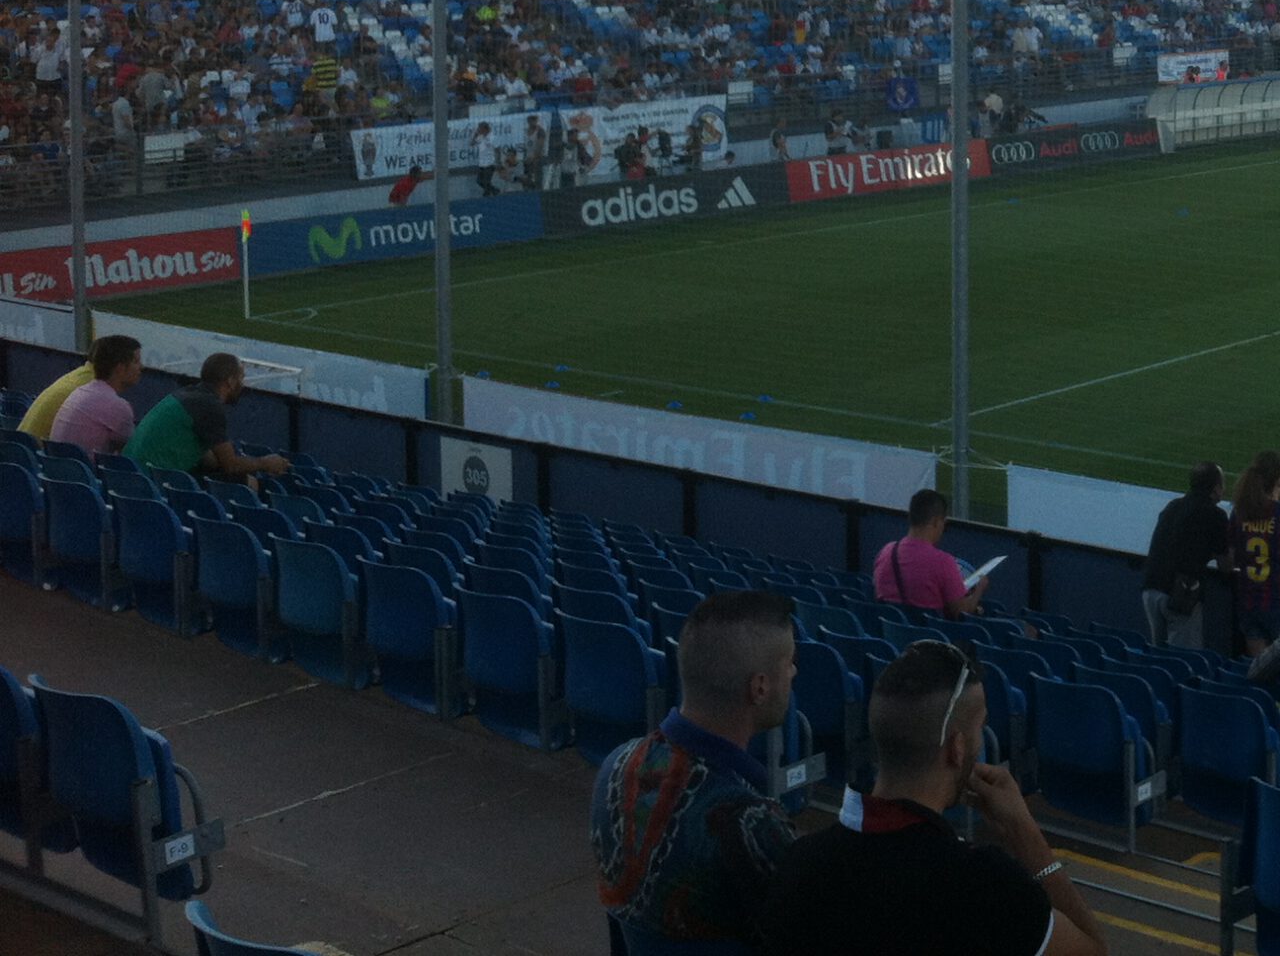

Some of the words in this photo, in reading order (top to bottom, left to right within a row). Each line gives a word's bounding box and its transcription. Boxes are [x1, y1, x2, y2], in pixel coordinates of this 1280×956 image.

[318, 13, 329, 24] 10
[1039, 139, 1078, 158] Audi
[1122, 130, 1158, 146] Audi
[384, 154, 407, 170] WE
[409, 153, 433, 166] ARE
[807, 159, 857, 195] Fly
[581, 183, 698, 226] adidas
[370, 213, 482, 247] movitar
[64, 248, 198, 291] Mahou
[200, 251, 235, 273] Sin
[464, 466, 488, 487] 305
[1246, 536, 1271, 582] 3
